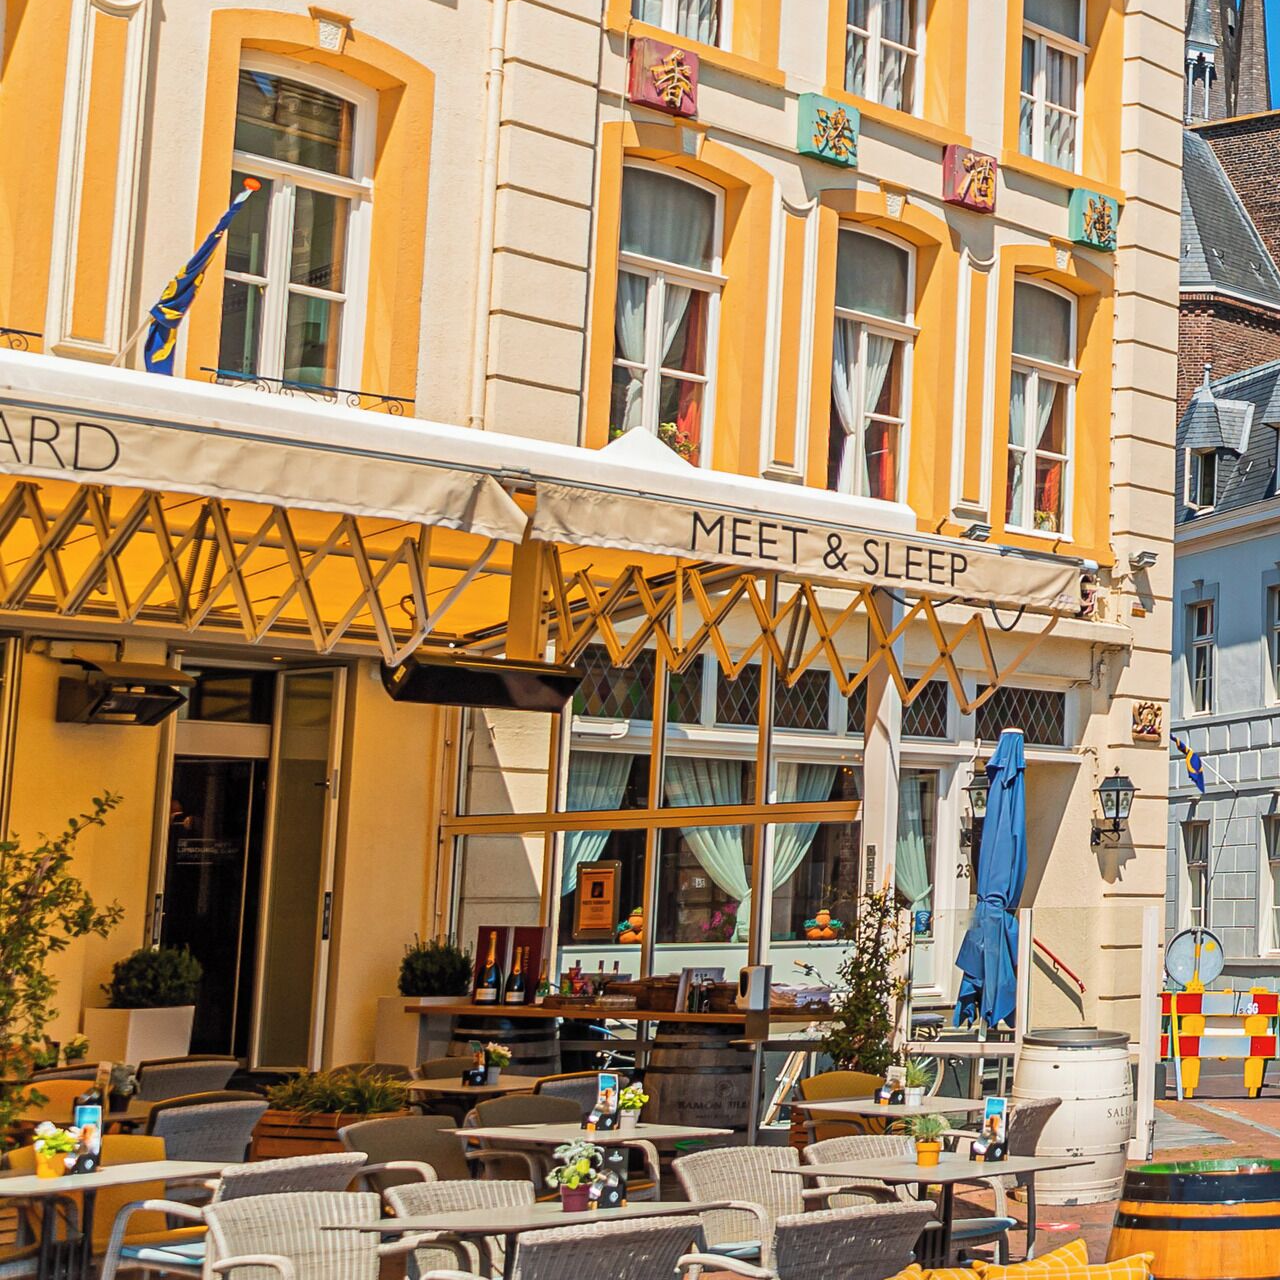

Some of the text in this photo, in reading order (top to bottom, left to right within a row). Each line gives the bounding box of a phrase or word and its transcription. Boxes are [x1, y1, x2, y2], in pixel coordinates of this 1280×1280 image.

[691, 511, 968, 587] MEET & SLEEP
[956, 863, 971, 879] 23
